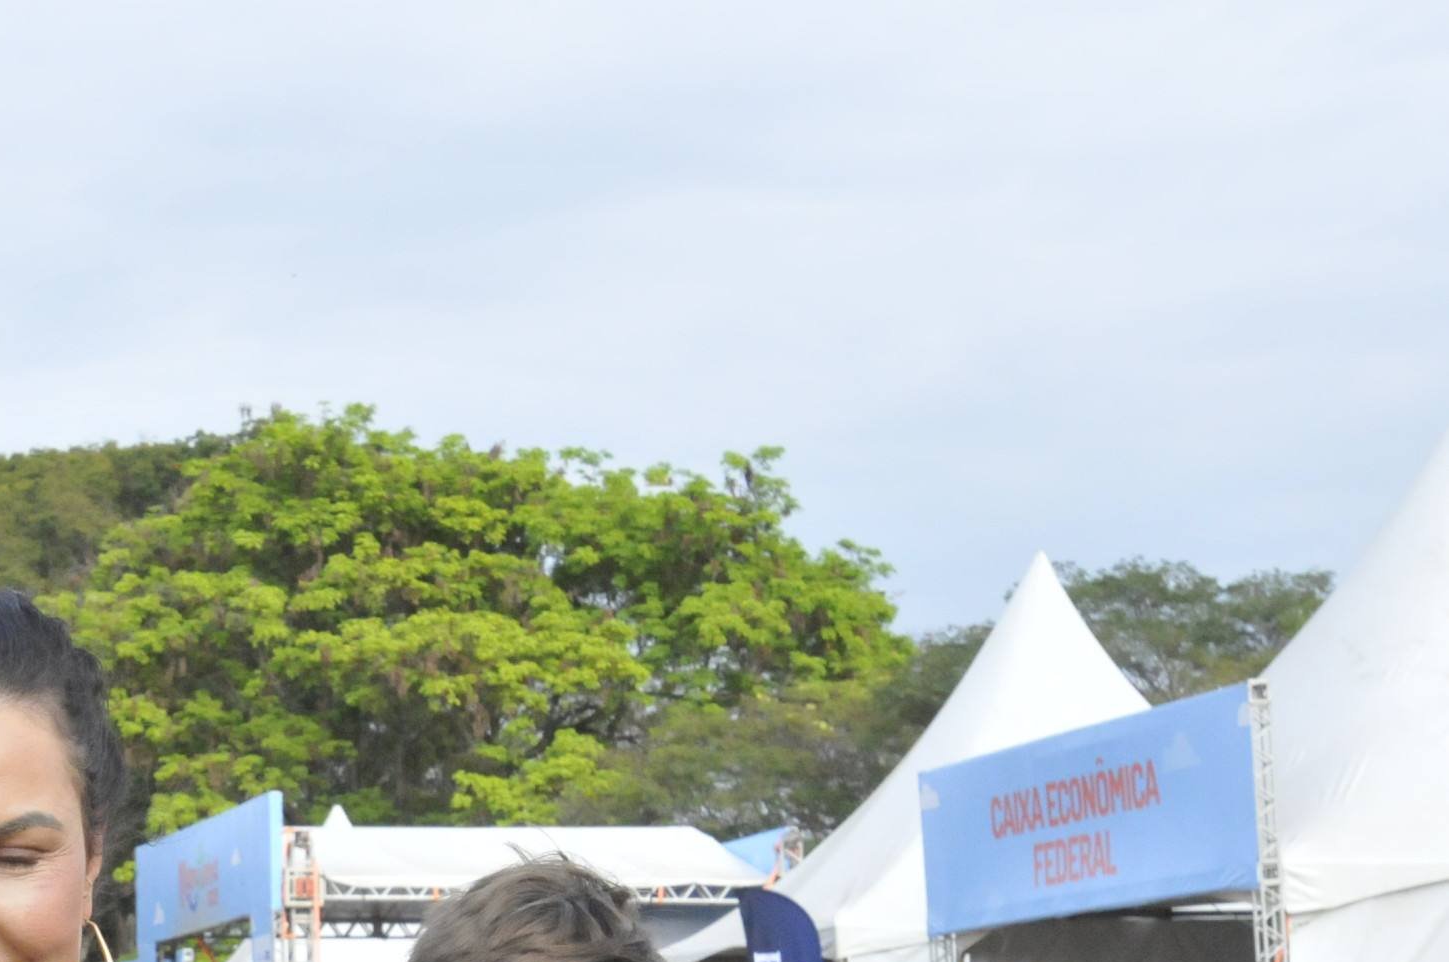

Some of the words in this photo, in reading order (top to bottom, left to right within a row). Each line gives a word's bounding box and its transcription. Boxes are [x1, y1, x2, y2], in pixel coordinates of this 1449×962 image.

[990, 786, 1045, 839] CAIXA
[1045, 756, 1161, 827] ECONÔMICA
[1033, 829, 1117, 888] FEDERAL
